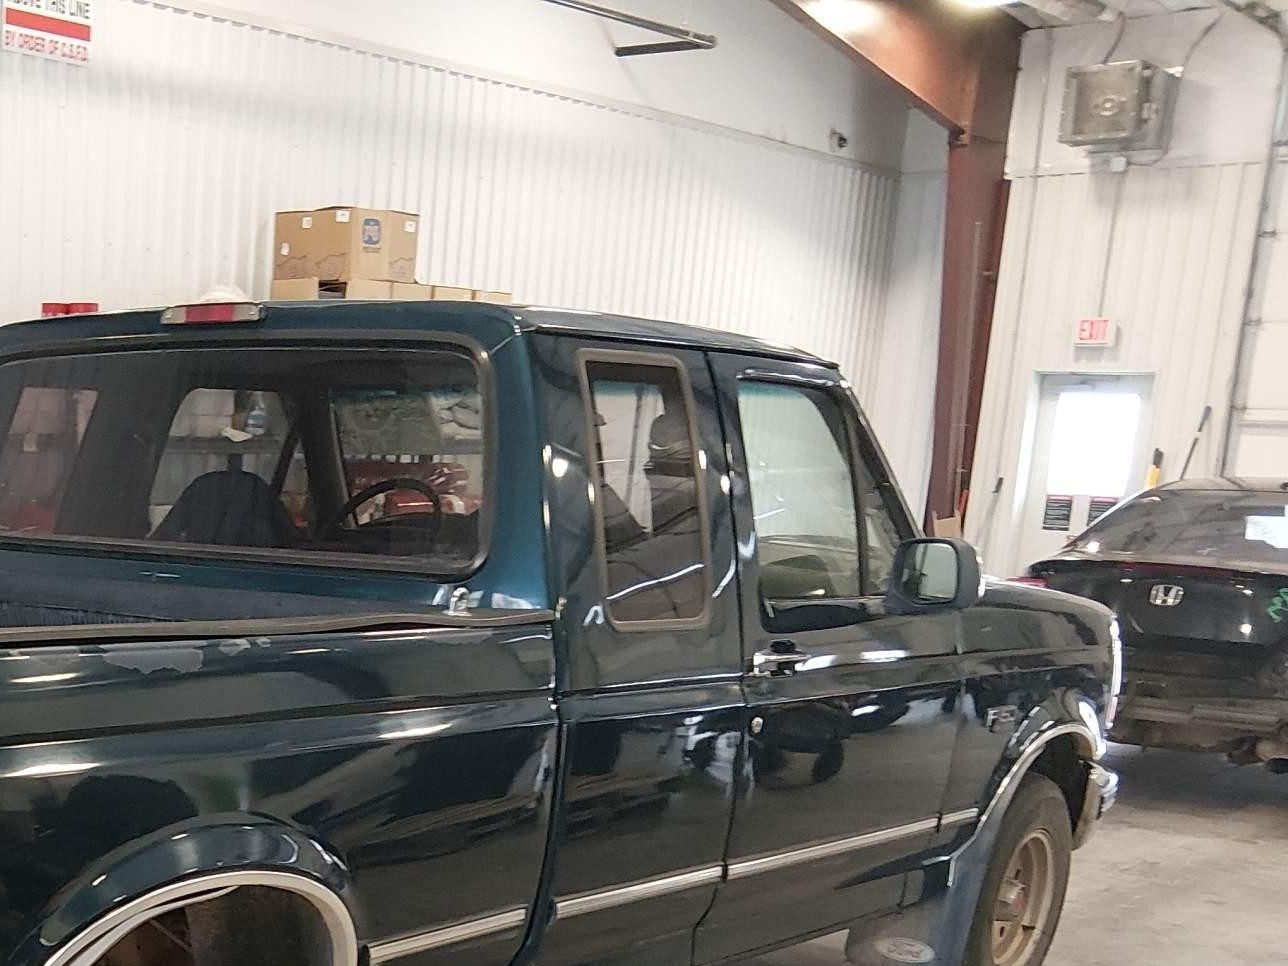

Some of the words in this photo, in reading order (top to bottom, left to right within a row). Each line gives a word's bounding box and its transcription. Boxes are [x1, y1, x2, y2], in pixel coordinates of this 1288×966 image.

[69, 0, 90, 19] LINE
[4, 30, 16, 47] BY
[18, 33, 46, 53] ORDER
[48, 39, 60, 55] OF
[1079, 319, 1109, 340] EXIT
